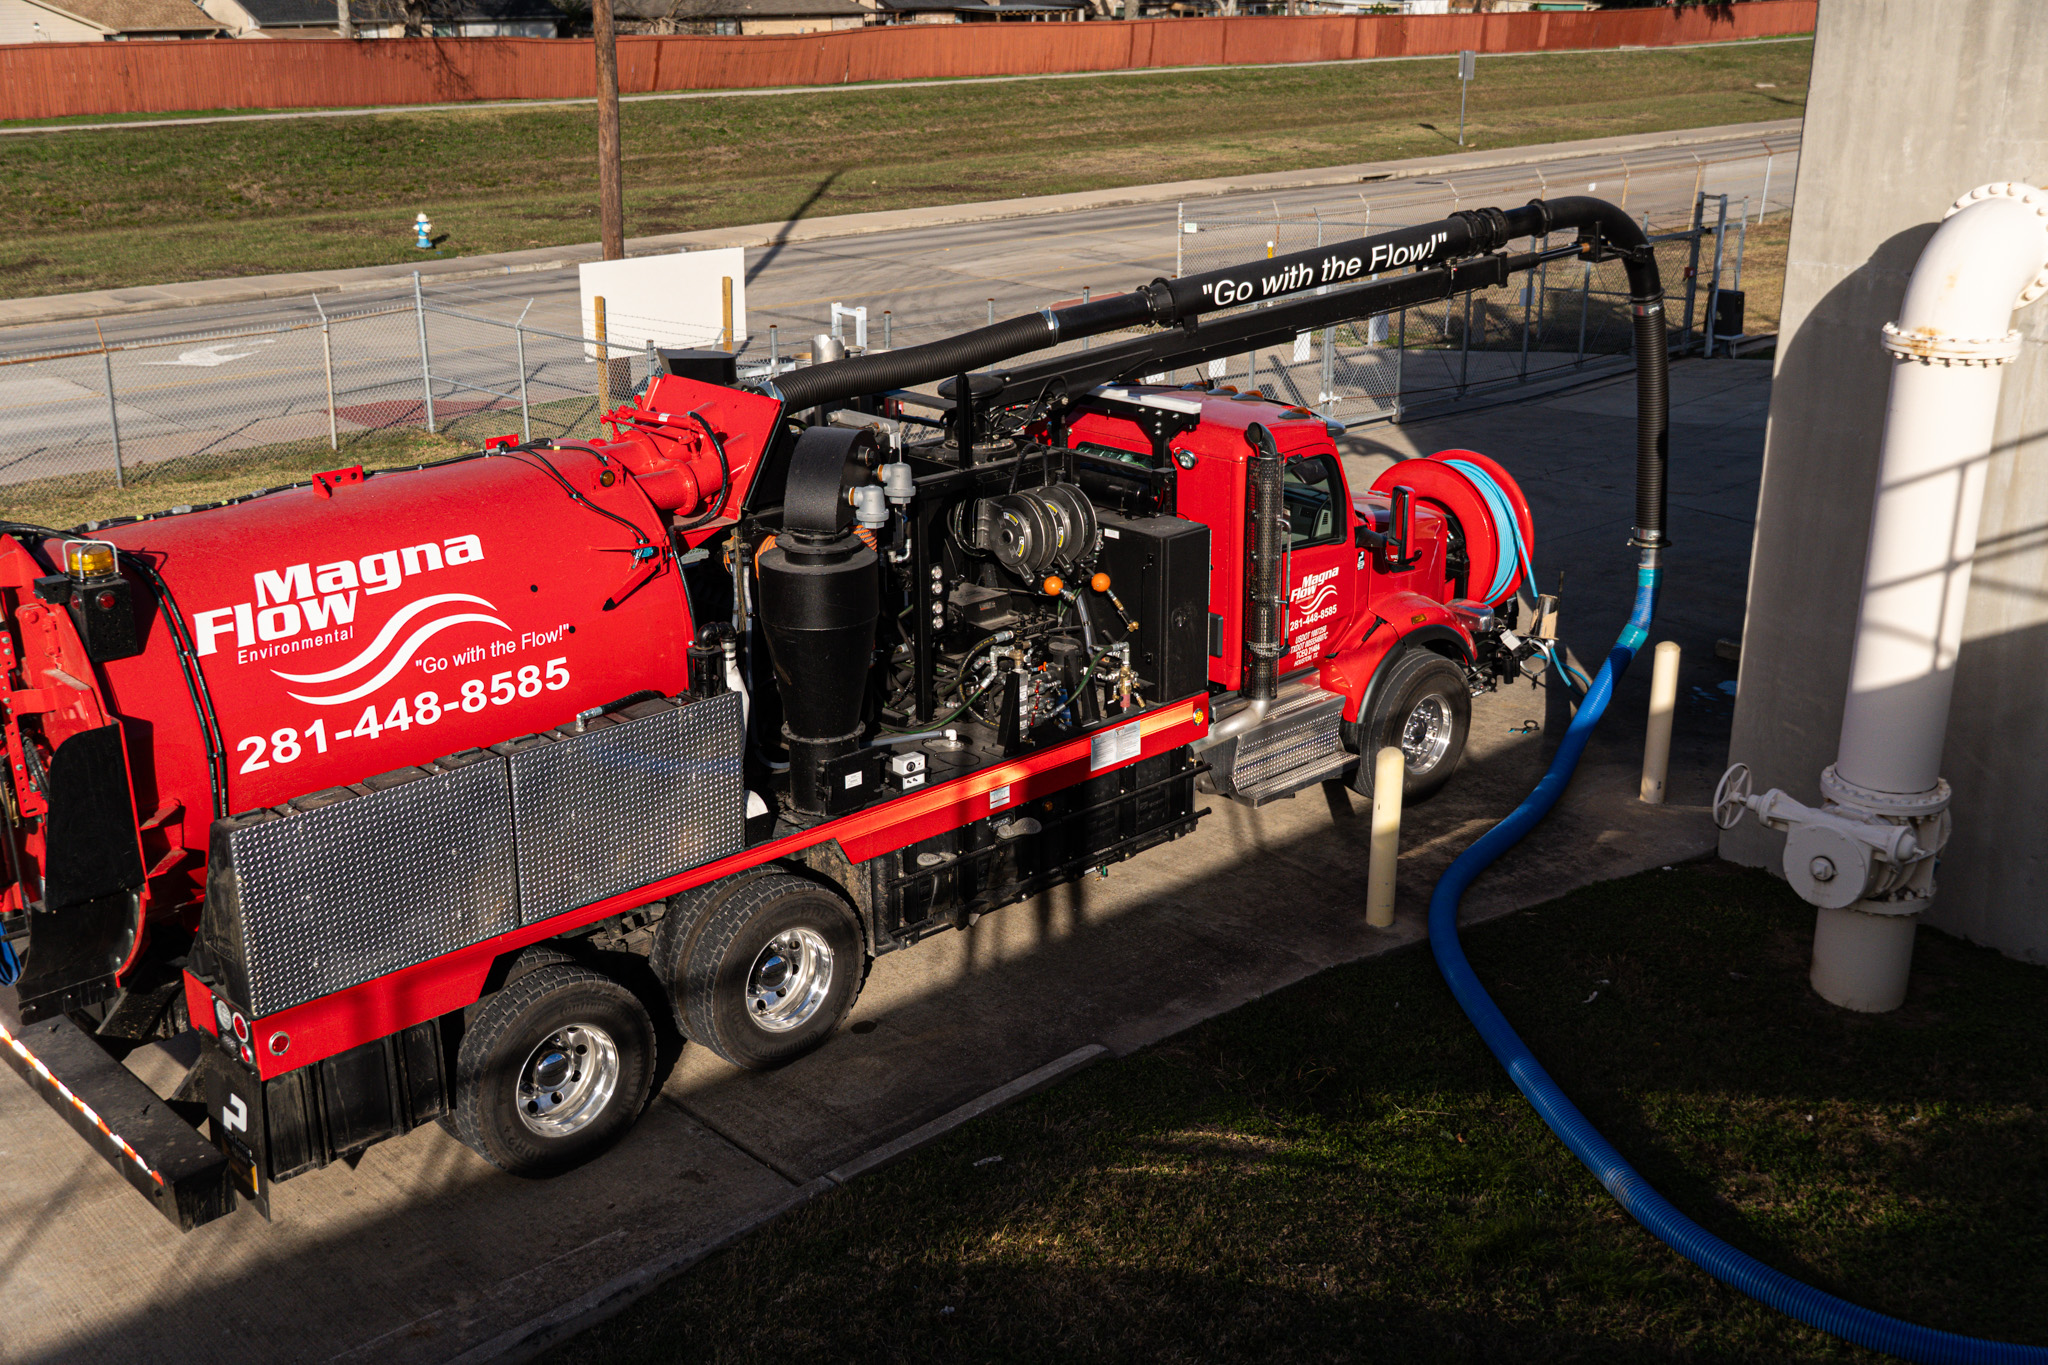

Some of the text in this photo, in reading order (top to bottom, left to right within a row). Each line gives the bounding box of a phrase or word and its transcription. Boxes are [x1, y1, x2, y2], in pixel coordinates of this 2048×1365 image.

[1202, 231, 1448, 306] "Go with the Flow!"
[253, 533, 485, 608] Magna
[1290, 584, 1317, 602] Flow
[1302, 567, 1339, 588] Magna
[192, 590, 359, 657] Flow
[1290, 604, 1337, 631] 281-448-8585
[237, 625, 355, 665] Environmental
[415, 623, 570, 675] "Go with the Flow!"
[236, 656, 572, 775] 281-448-8585
